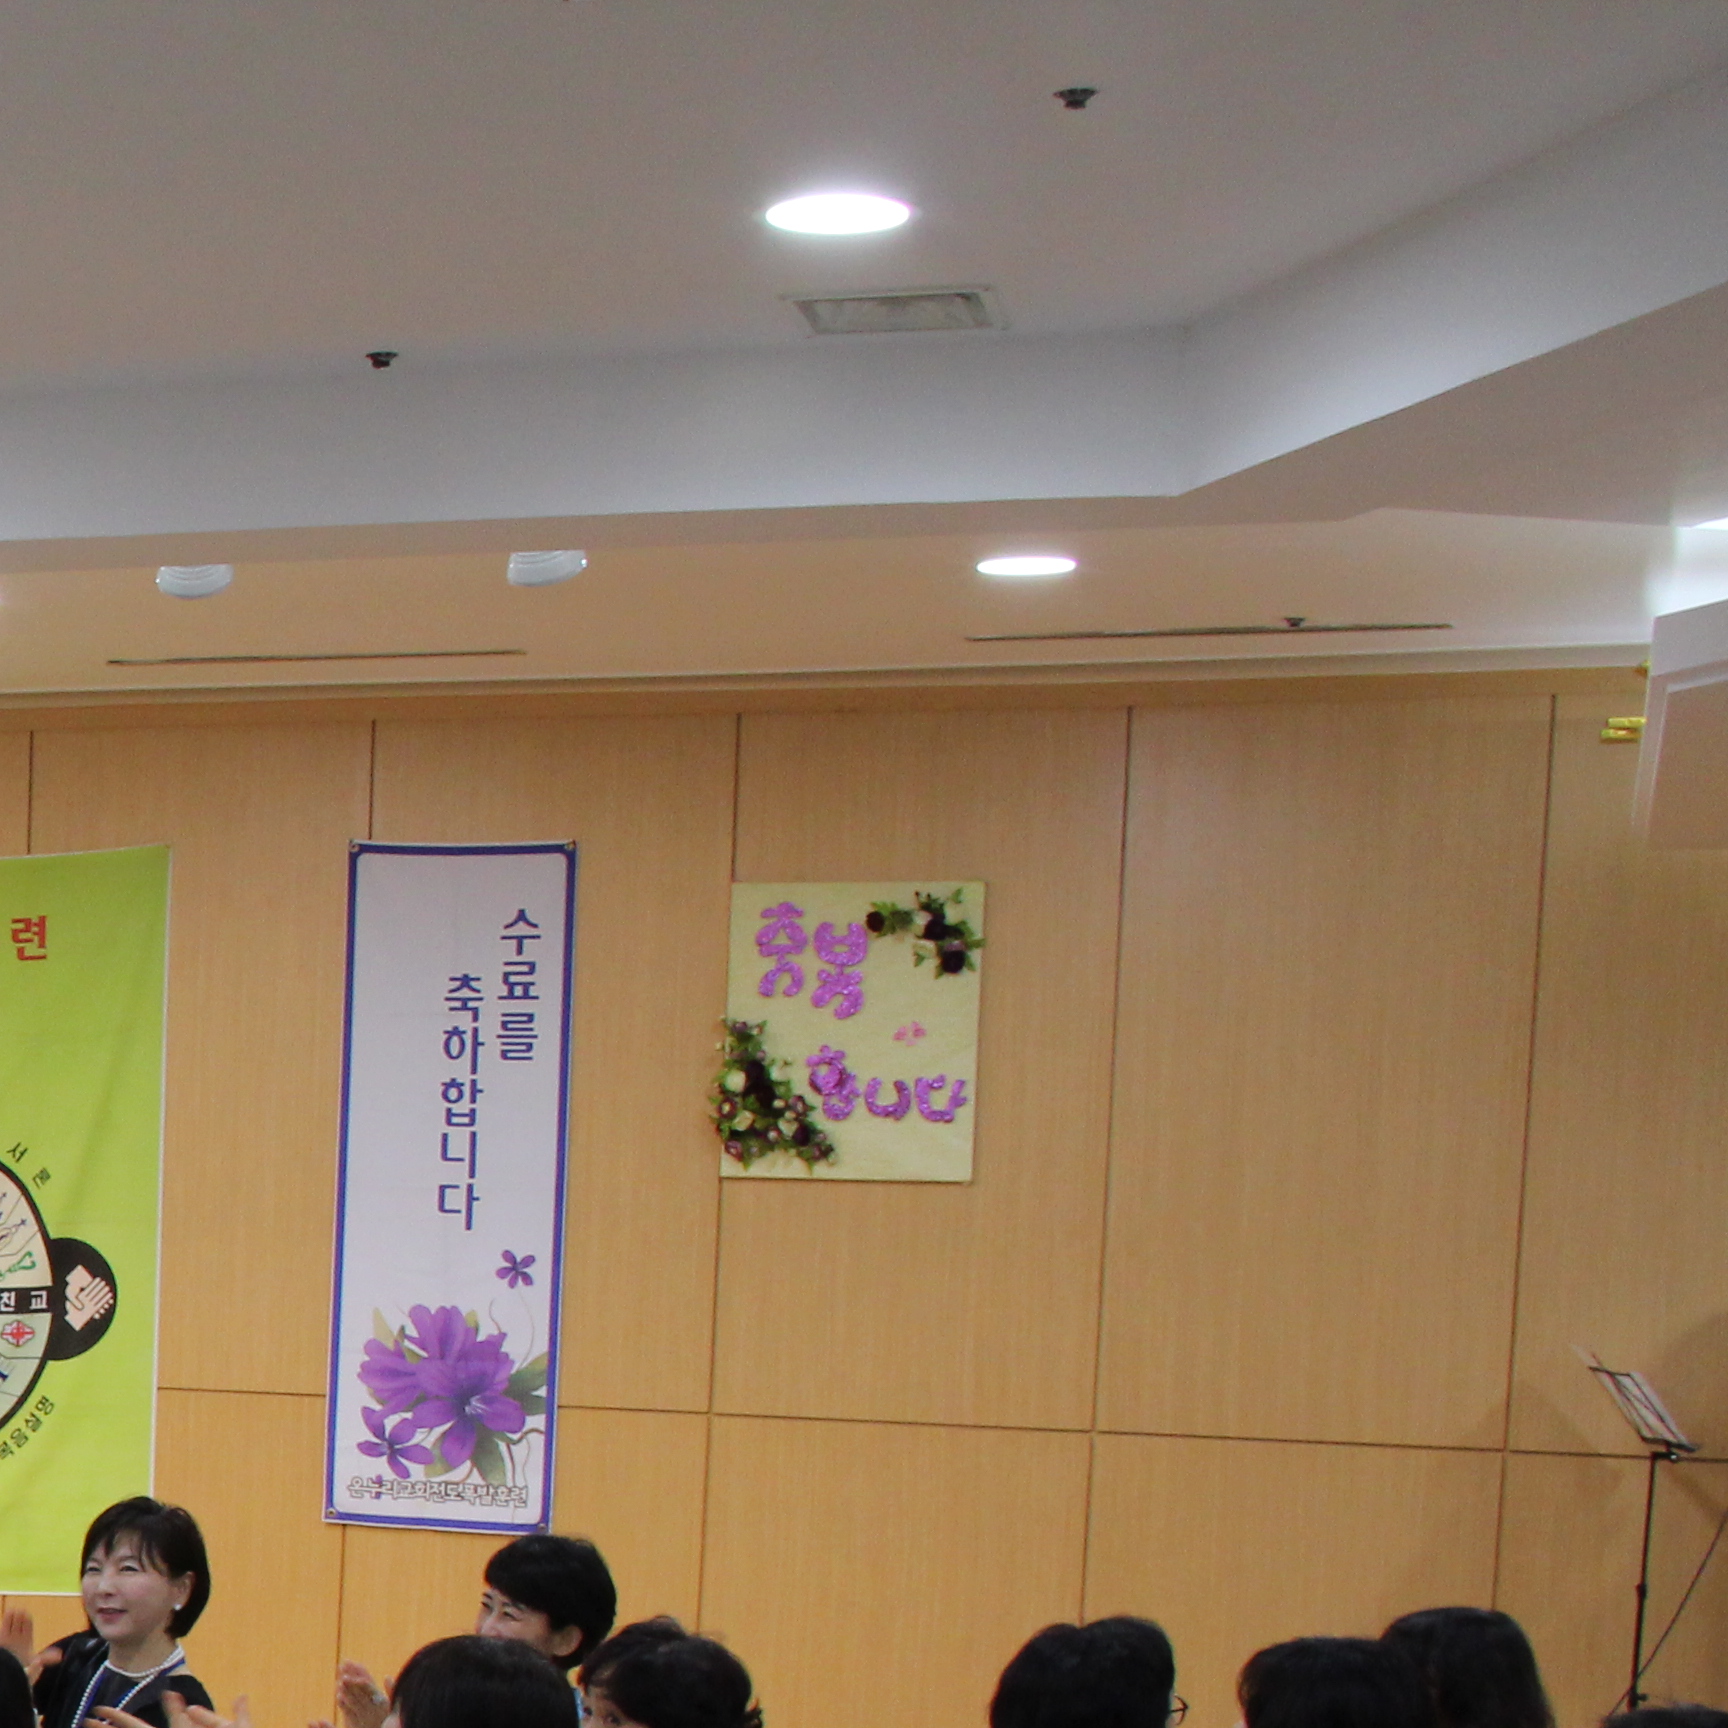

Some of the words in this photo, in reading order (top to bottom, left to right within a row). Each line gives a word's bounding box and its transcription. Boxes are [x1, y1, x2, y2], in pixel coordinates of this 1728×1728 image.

[496, 907, 542, 1062] 수료를
[755, 901, 868, 1019] 축복
[436, 972, 485, 1232] 축하합니다
[806, 1044, 968, 1124] 합니다
